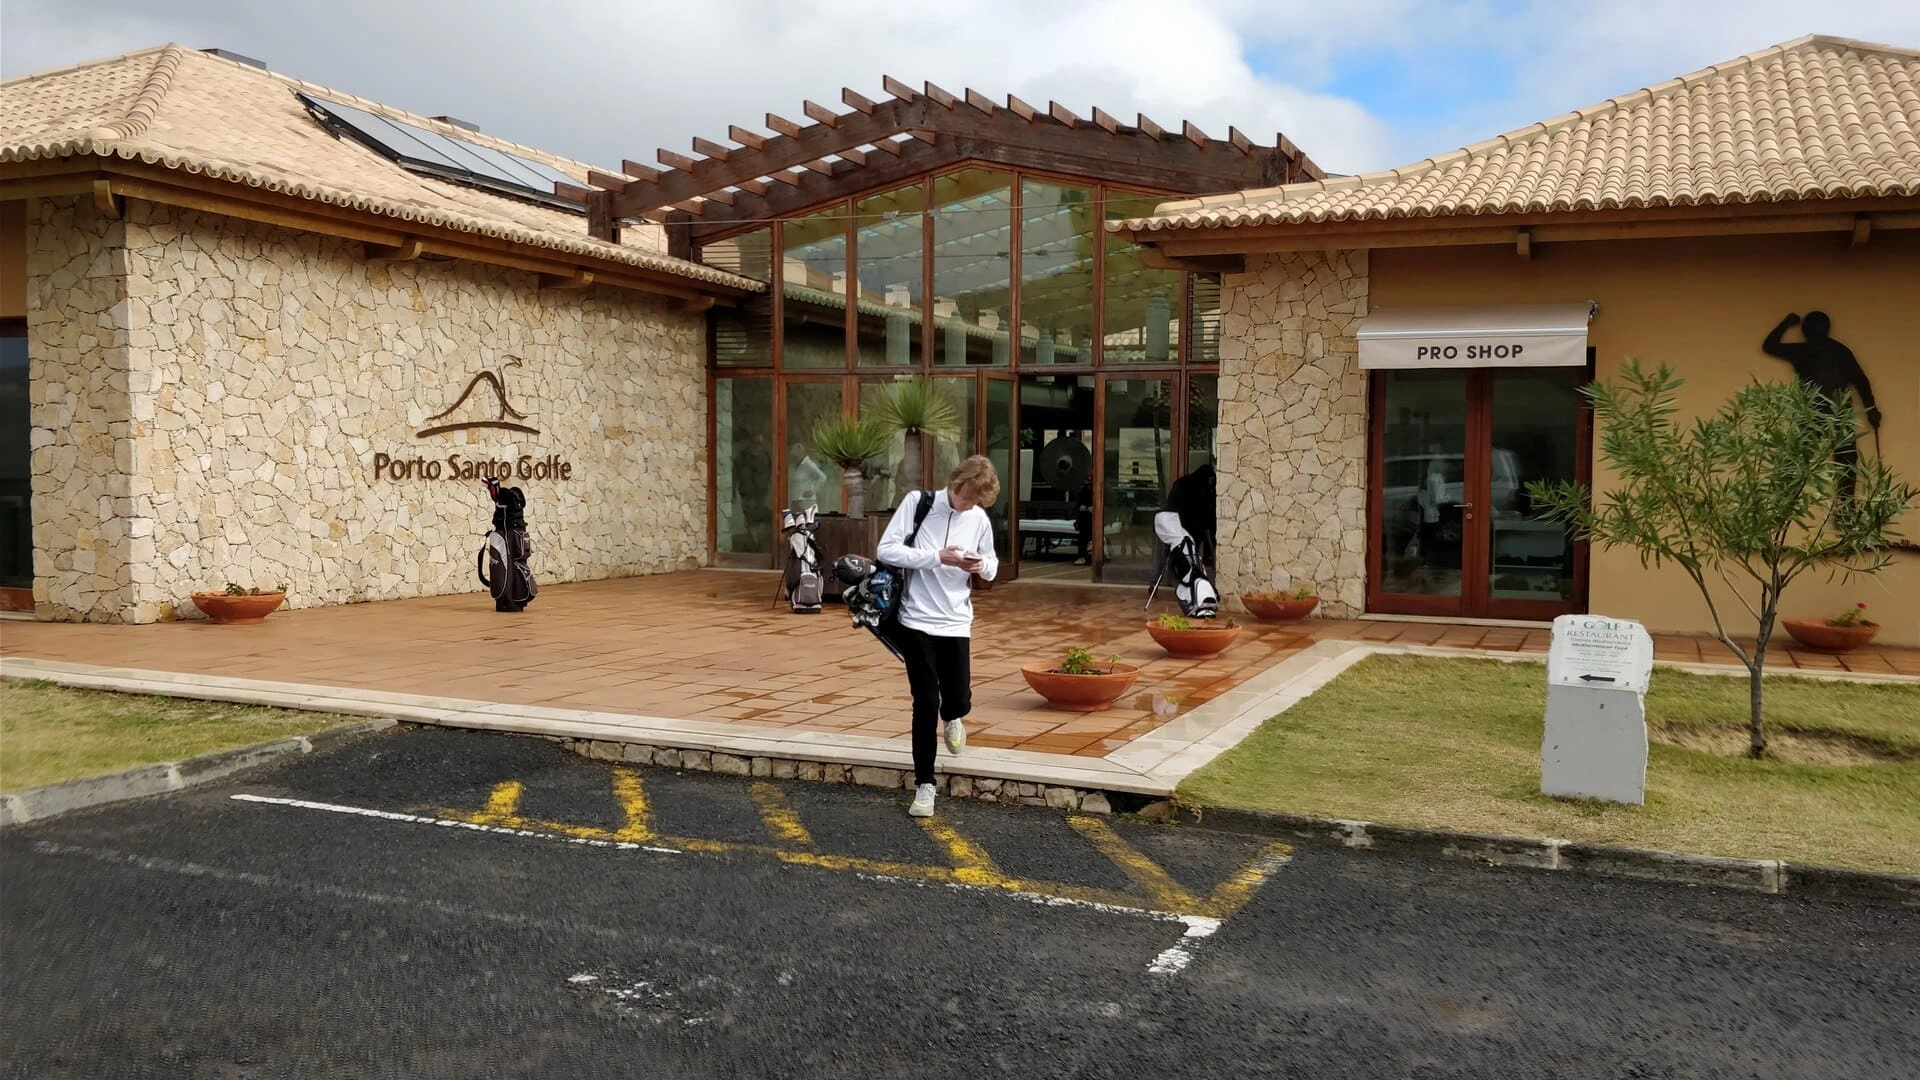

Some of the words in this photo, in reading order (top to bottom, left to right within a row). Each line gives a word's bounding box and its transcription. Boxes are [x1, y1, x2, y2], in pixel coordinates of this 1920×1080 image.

[1418, 346, 1458, 360] PRO
[1466, 345, 1523, 359] SHOP
[374, 453, 441, 480] Porto
[448, 453, 512, 480] Santo
[517, 454, 571, 481] Golfe
[1583, 620, 1620, 630] GOLF
[1567, 630, 1634, 641] RESTAURANT
